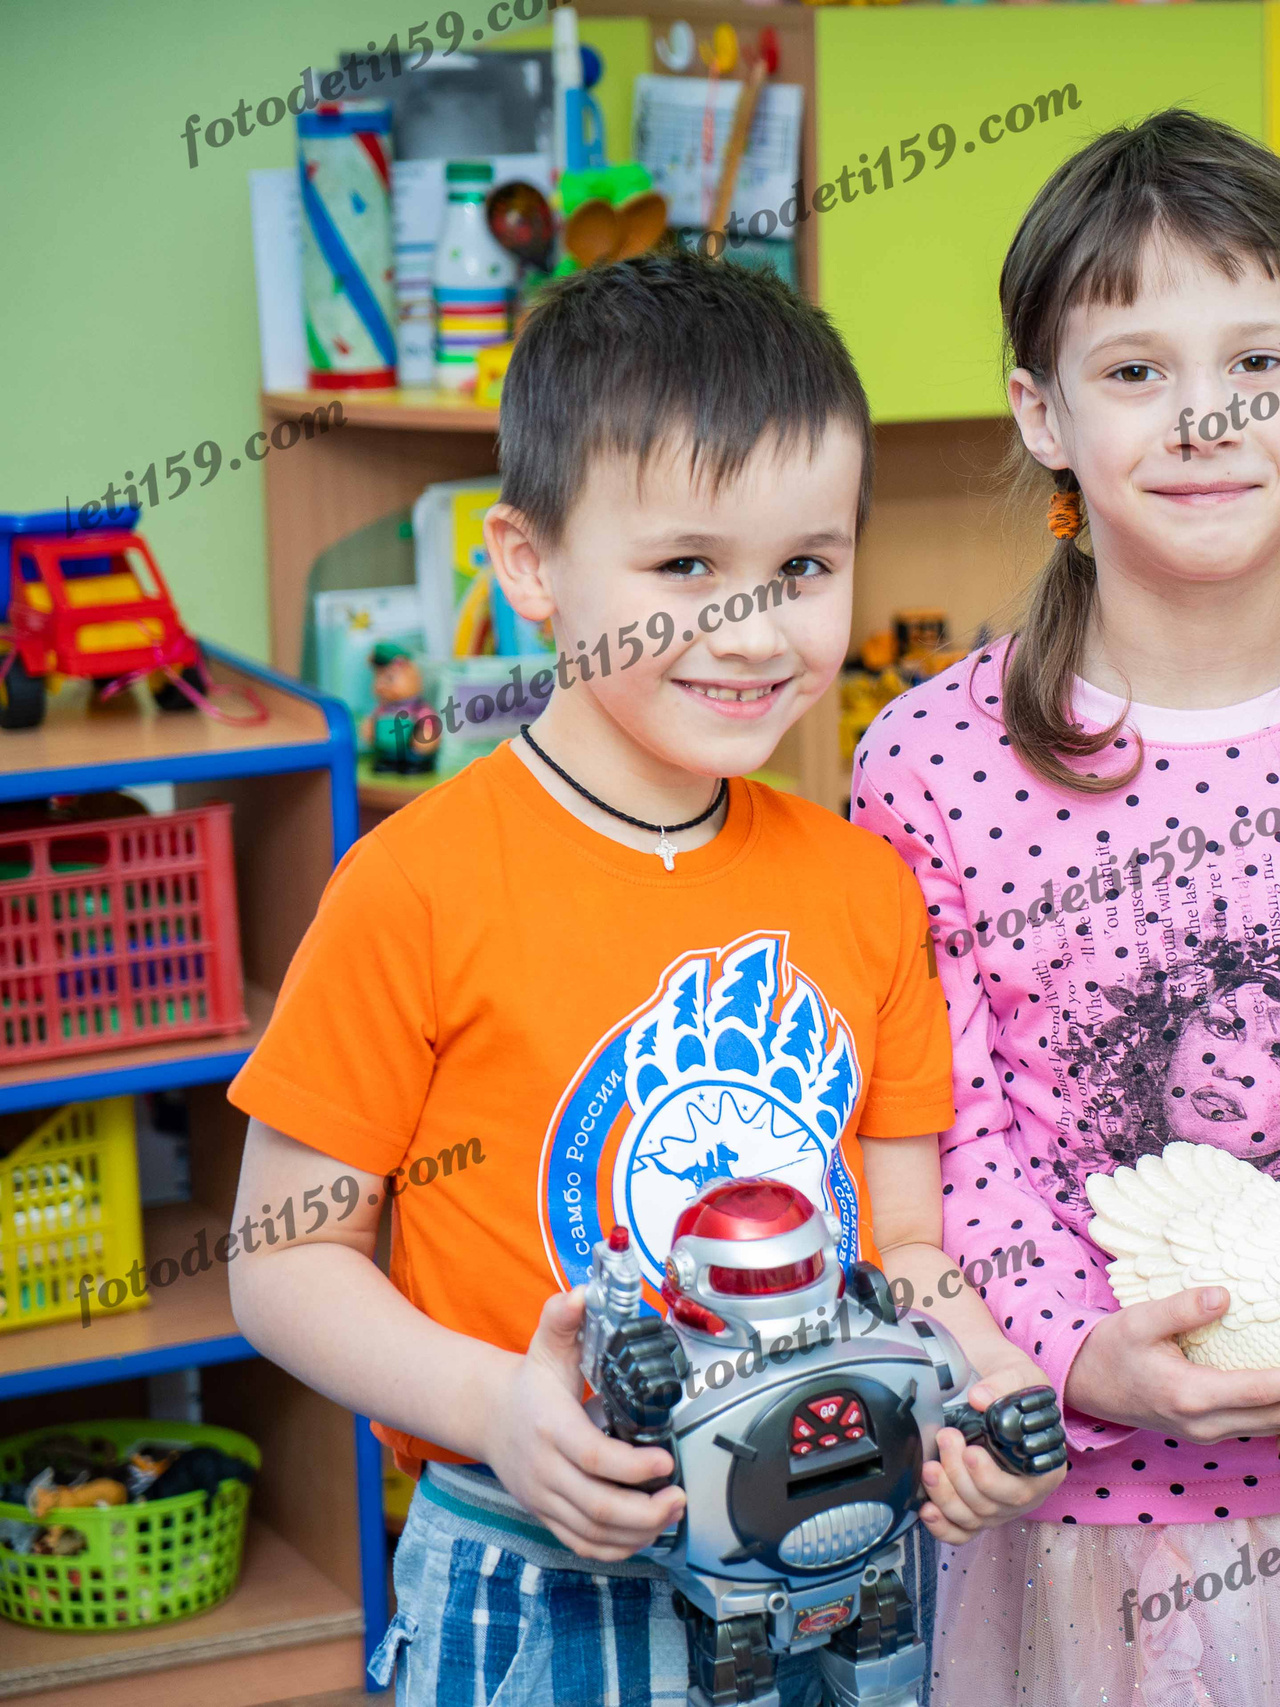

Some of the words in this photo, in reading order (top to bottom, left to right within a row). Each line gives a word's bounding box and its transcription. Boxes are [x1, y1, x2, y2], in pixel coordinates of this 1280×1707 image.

[1261, 853, 1275, 880] me
[1152, 875, 1171, 912] with
[1207, 873, 1228, 929] thy're
[1130, 890, 1147, 936] cause
[1184, 909, 1200, 935] the
[1051, 918, 1069, 949] sick
[1136, 941, 1152, 970] just
[1032, 960, 1054, 991] with
[1044, 991, 1058, 1002] it
[1067, 980, 1081, 1004] yo
[1047, 1005, 1062, 1052] spend
[1054, 1068, 1071, 1103] must
[1075, 1077, 1090, 1096] on
[566, 1069, 623, 1163] России
